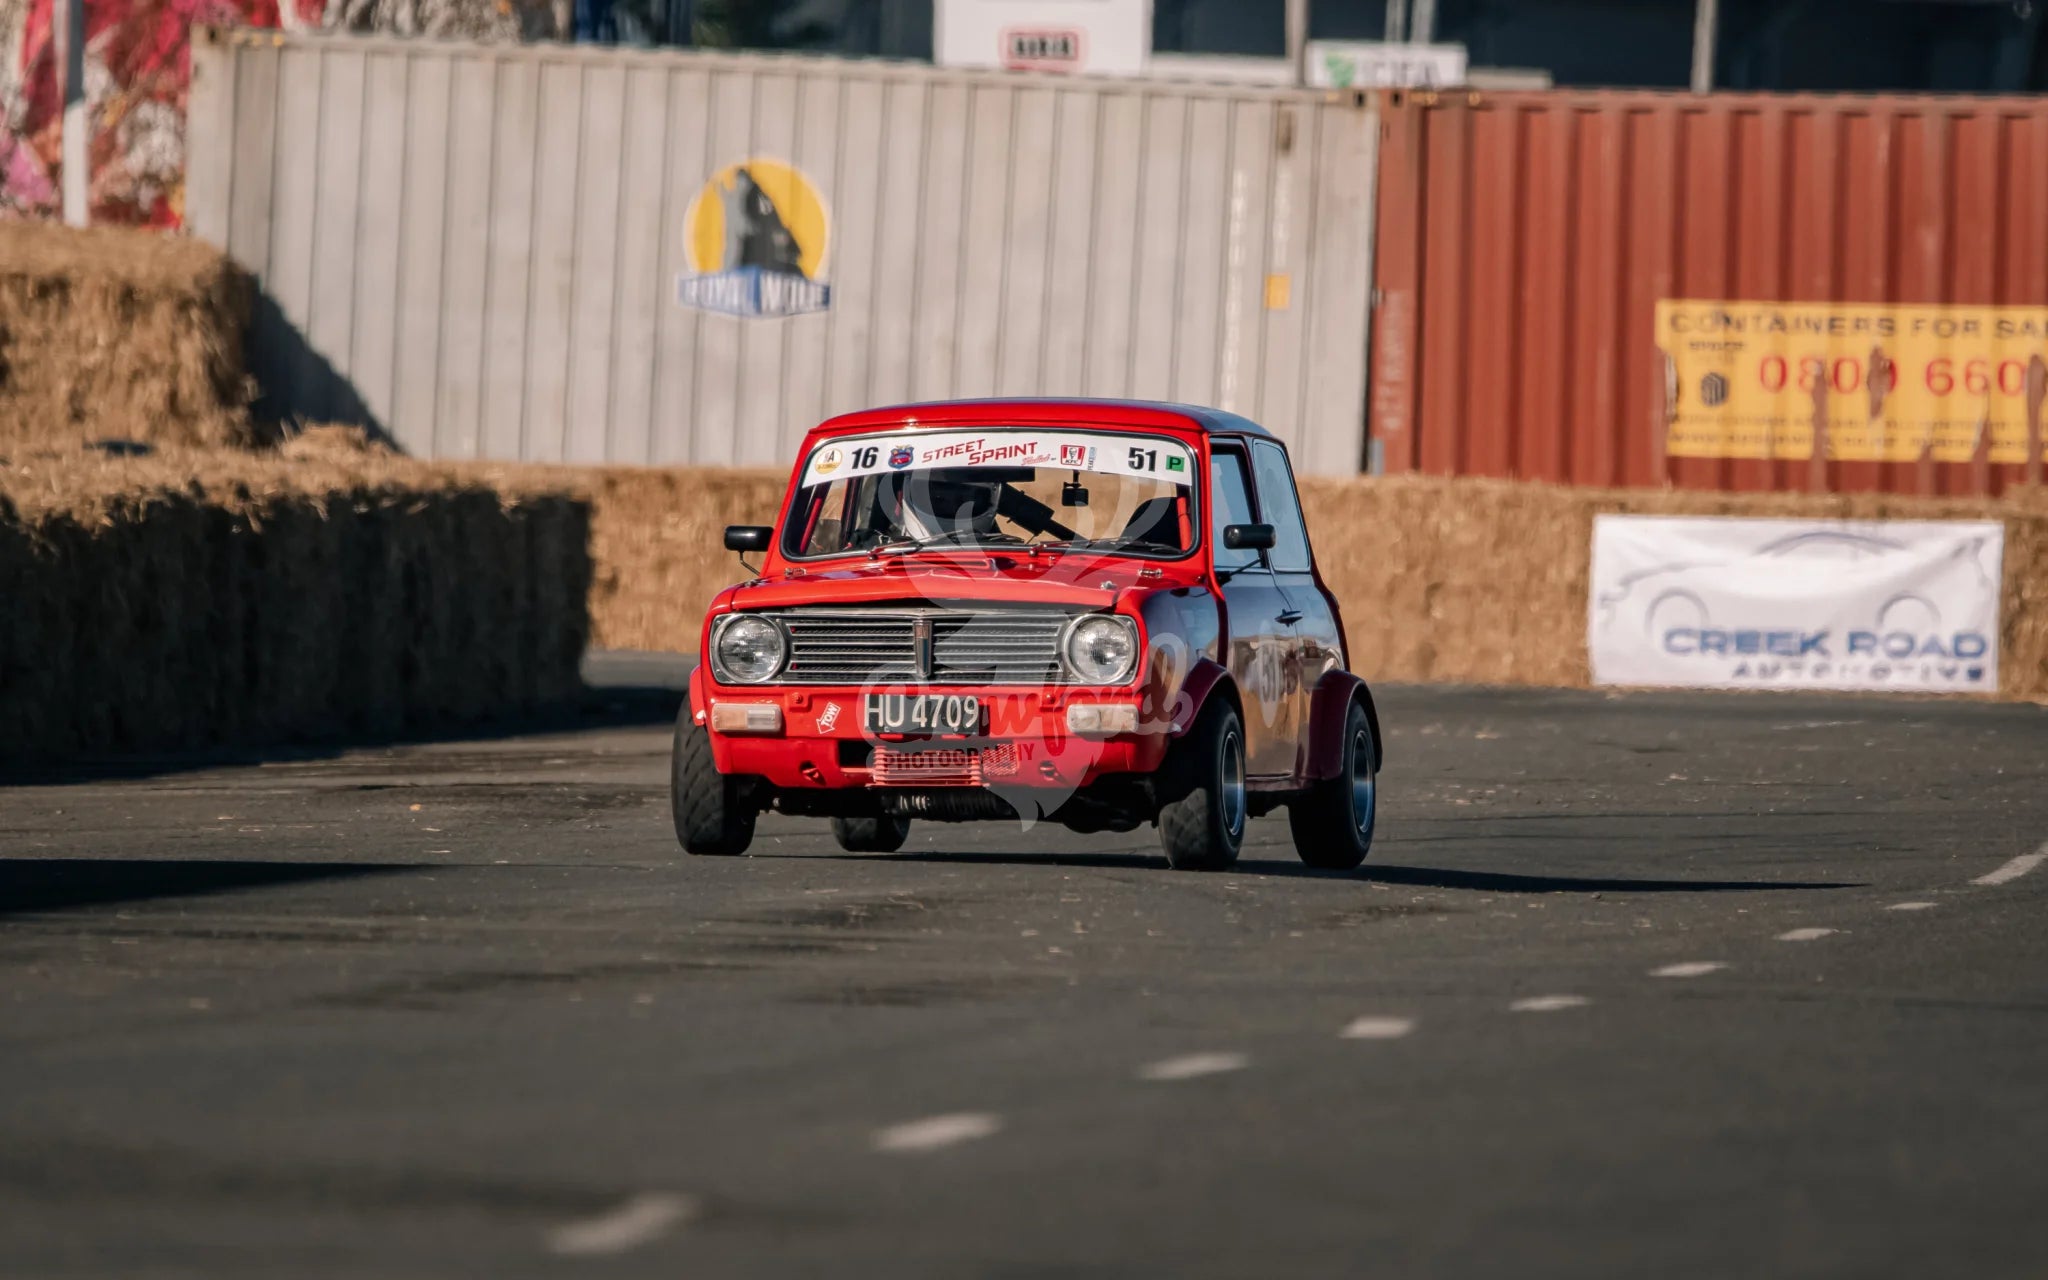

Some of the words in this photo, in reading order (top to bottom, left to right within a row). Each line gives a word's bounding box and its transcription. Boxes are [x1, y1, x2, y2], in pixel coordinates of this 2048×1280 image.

[1669, 312, 1897, 336] CONTAINERS
[1910, 317, 1983, 338] FOR
[1994, 316, 2048, 339] SA
[1924, 357, 2028, 397] 660
[851, 446, 880, 470] 16
[922, 438, 985, 463] STREET
[968, 441, 1038, 466] SPRINT
[1127, 446, 1158, 473] 51
[1168, 456, 1182, 470] P
[1662, 627, 1831, 657] CREEK
[1847, 629, 1987, 659] ROAD
[820, 702, 839, 728] TOW
[864, 693, 904, 728] HU
[911, 693, 980, 729] 4709
